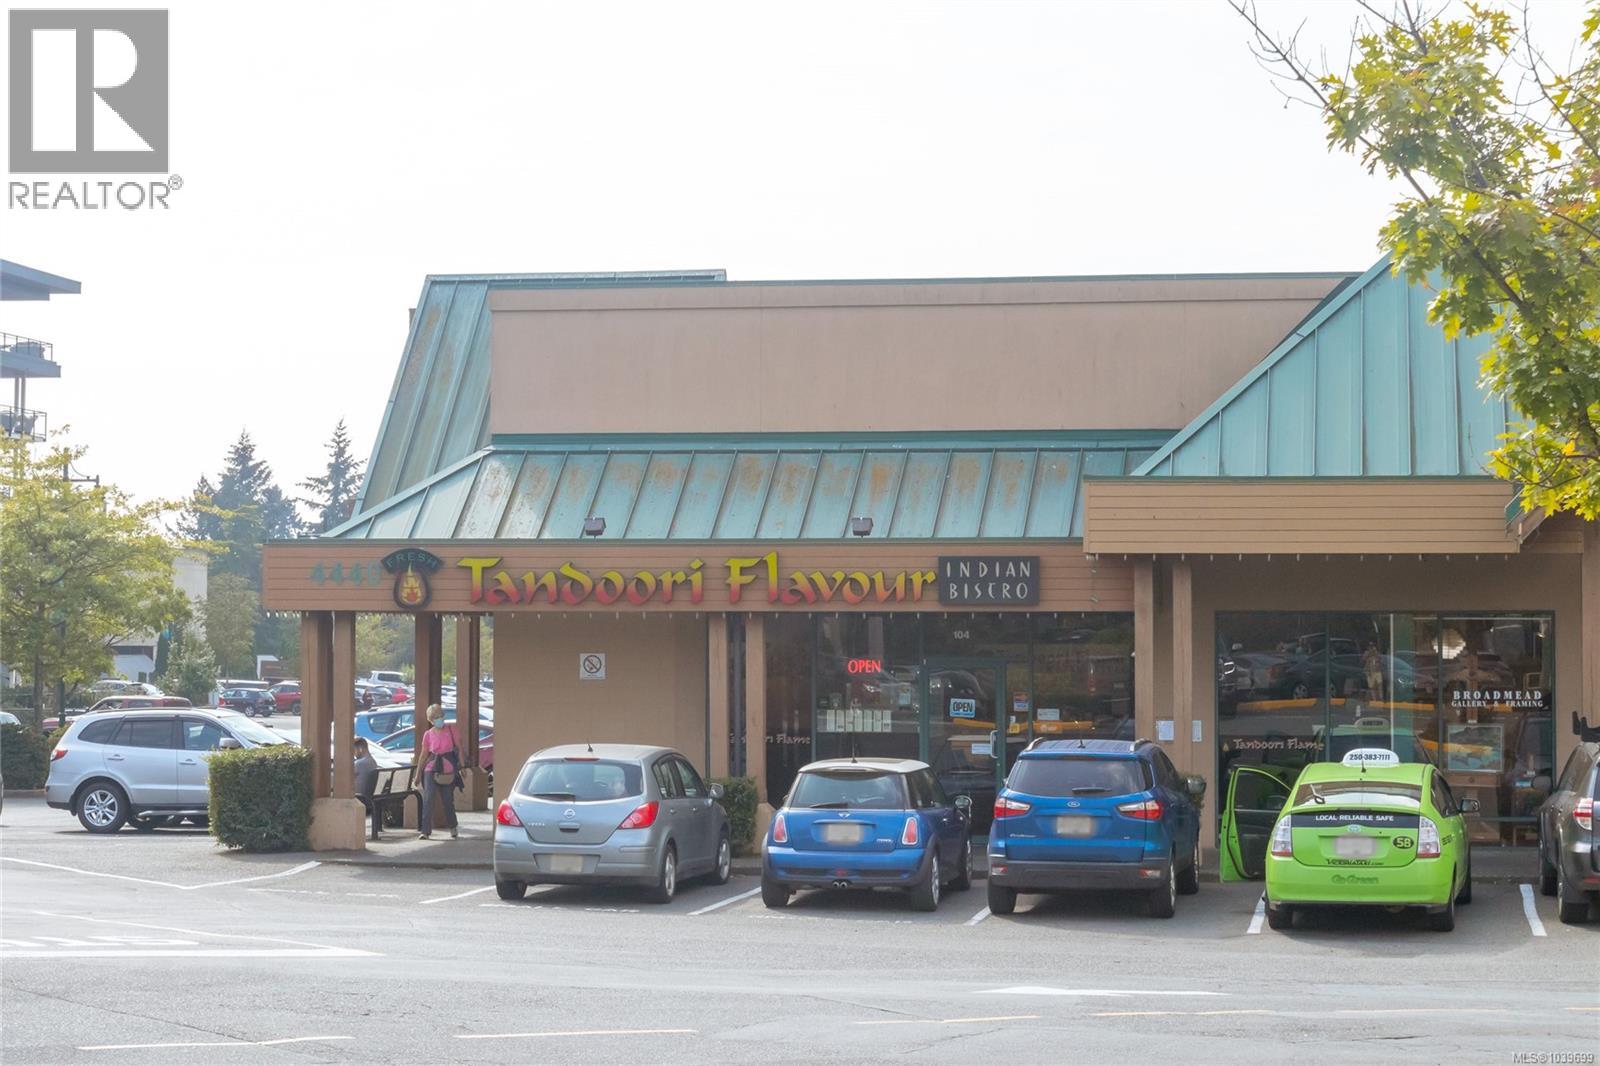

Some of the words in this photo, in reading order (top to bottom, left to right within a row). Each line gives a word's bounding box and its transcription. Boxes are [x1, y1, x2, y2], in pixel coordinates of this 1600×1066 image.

[385, 551, 439, 569] FRESH
[945, 560, 1032, 578] INDIAN
[457, 556, 704, 606] Tandoori
[724, 551, 938, 606] Flavour
[948, 581, 1030, 600] BISTRO
[953, 630, 970, 640] 104
[847, 659, 882, 674] OPEN
[1453, 690, 1543, 700] BROADMEAD
[952, 701, 974, 713] OPEN
[1451, 700, 1488, 708] GALLERY
[1493, 700, 1500, 708] &
[1505, 700, 1544, 708] FRAMING
[1315, 814, 1338, 822] LOCAL
[1339, 814, 1374, 822] RELIABLE
[1375, 814, 1395, 822] SAFE
[1395, 837, 1412, 849] 58
